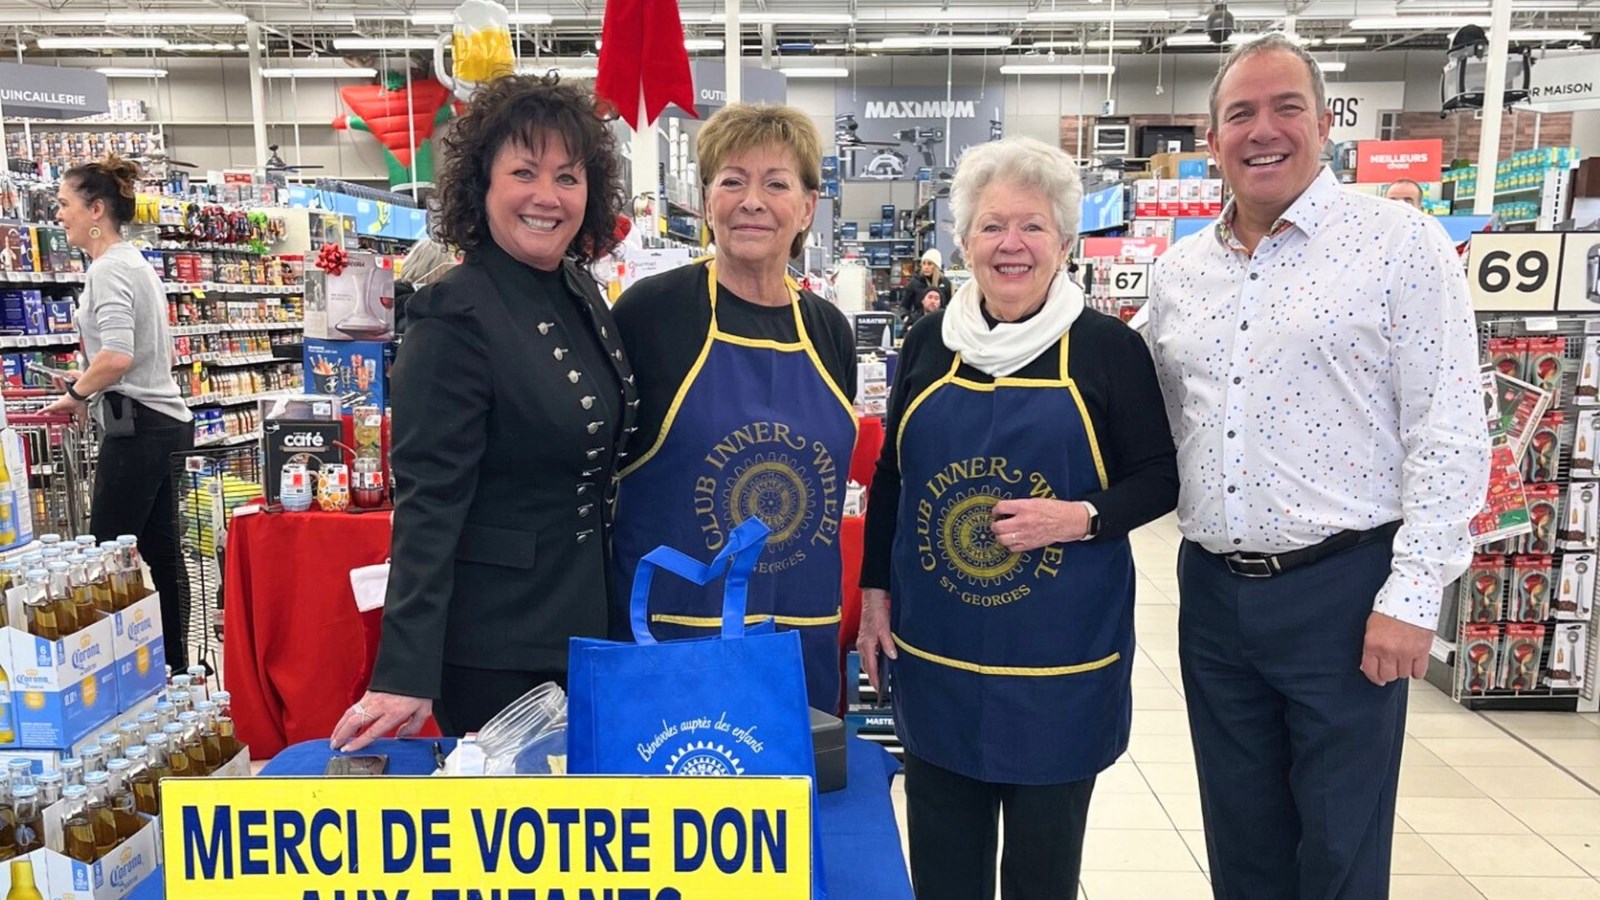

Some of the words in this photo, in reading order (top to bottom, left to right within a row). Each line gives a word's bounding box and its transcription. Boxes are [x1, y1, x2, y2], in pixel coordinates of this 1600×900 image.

[0, 88, 86, 106] UINCAILLERIE
[1529, 87, 1540, 97] R
[1544, 82, 1593, 97] MAISON
[864, 101, 975, 118] MAXIMUM
[1327, 97, 1359, 127] AS
[1370, 153, 1428, 163] MEILLEURS
[1115, 272, 1143, 290] 67
[1478, 250, 1549, 293] 69
[284, 432, 324, 446] café
[705, 421, 806, 472] INNER
[926, 456, 1023, 500] INNER
[811, 441, 839, 547] WHEEL
[695, 476, 723, 550] CLUB
[1029, 472, 1065, 579] WEL
[918, 499, 937, 571] CLUB
[939, 576, 1031, 607] ST-GEORGES
[40, 645, 46, 655] 6
[72, 643, 101, 669] Corona
[16, 675, 49, 685] Corona
[637, 719, 678, 762] Bénévoles
[680, 716, 711, 734] auprès
[714, 711, 731, 732] des
[732, 725, 764, 753] enfants
[182, 805, 359, 880] MERCI
[381, 809, 451, 873] DE
[471, 807, 650, 874] VOTRE
[673, 807, 787, 874] DON
[77, 869, 83, 878] 6
[110, 854, 143, 888] Corona
